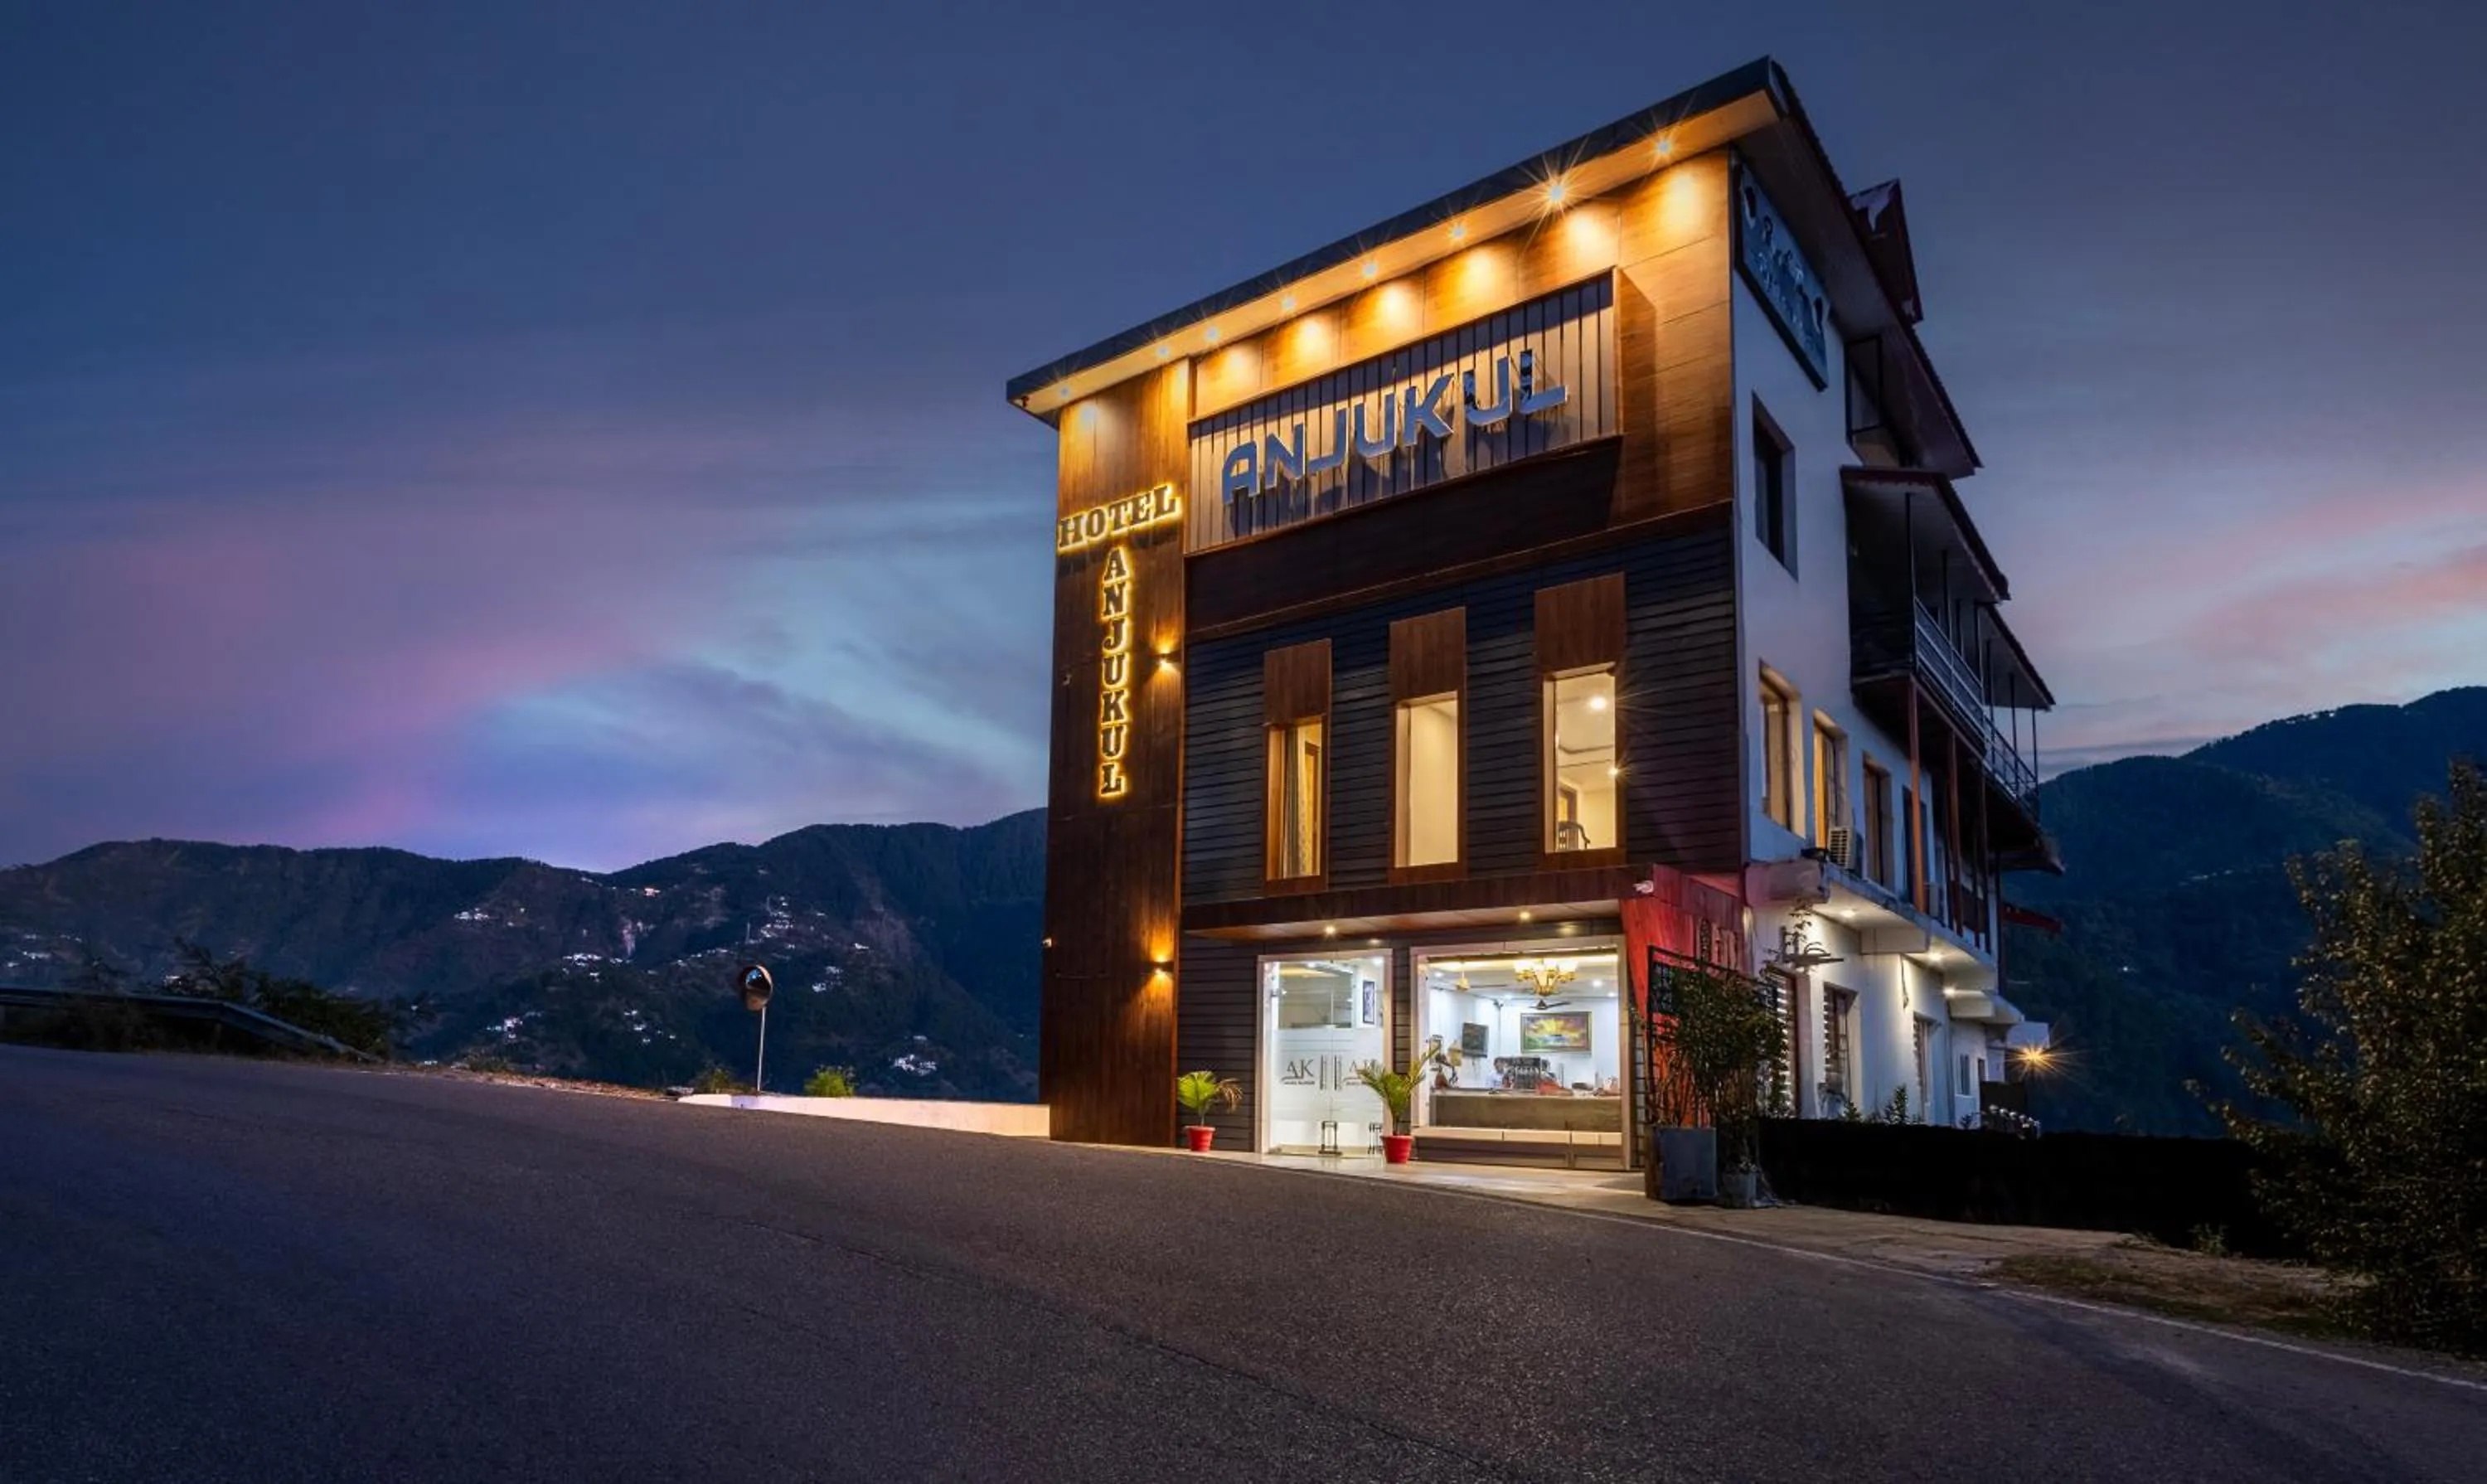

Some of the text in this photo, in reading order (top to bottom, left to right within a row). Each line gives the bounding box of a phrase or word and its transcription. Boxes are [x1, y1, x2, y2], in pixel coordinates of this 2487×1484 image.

[1222, 349, 1568, 505] ANJUKUL
[1059, 483, 1179, 550] HOTEL
[1100, 545, 1128, 796] ANJUKUL
